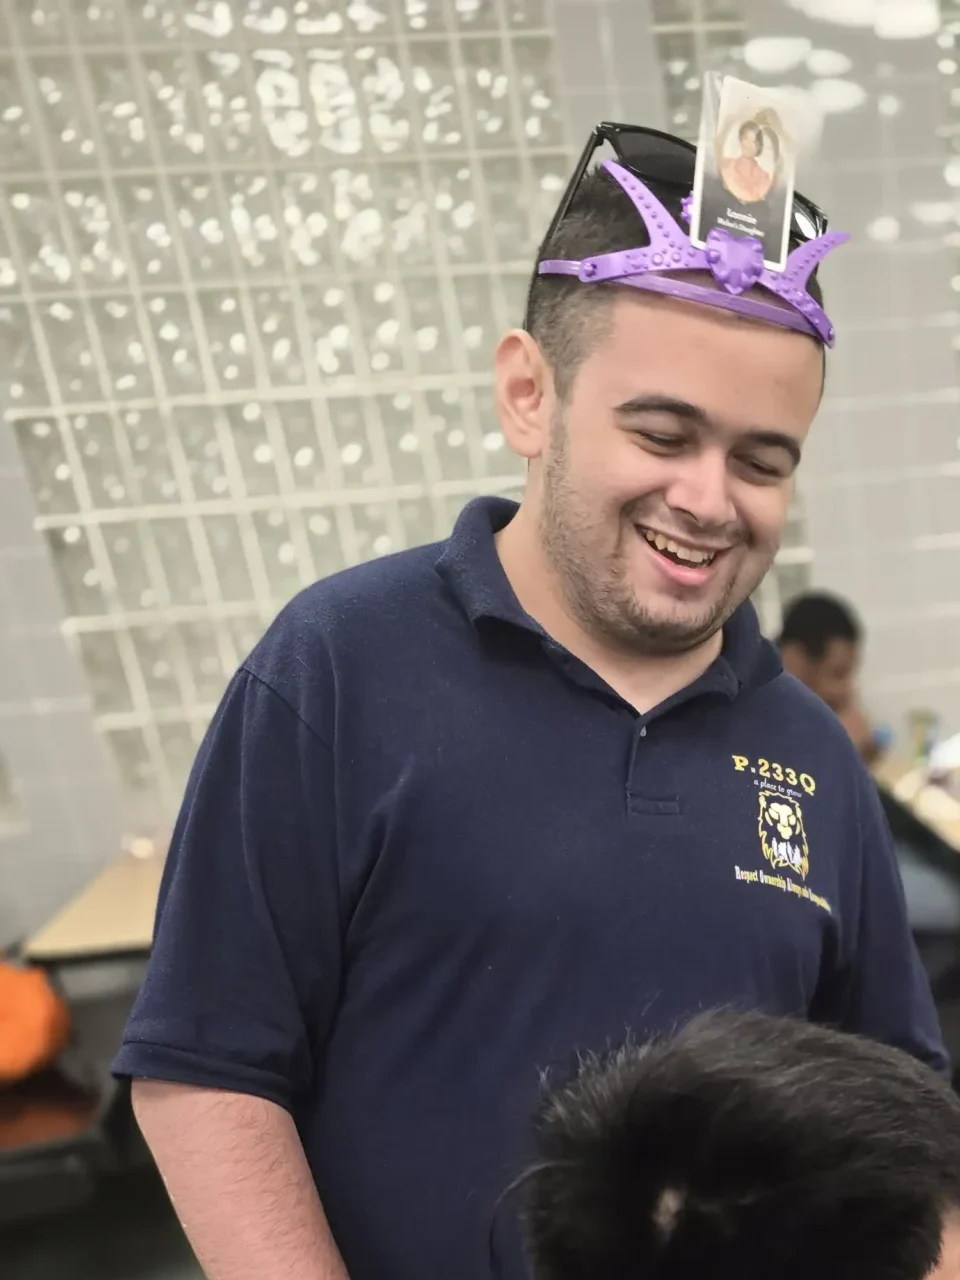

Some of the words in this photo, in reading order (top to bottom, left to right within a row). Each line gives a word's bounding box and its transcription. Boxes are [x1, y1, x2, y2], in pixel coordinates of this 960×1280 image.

[732, 755, 816, 796] P.233Q
[760, 778, 777, 793] place
[778, 783, 785, 793] to
